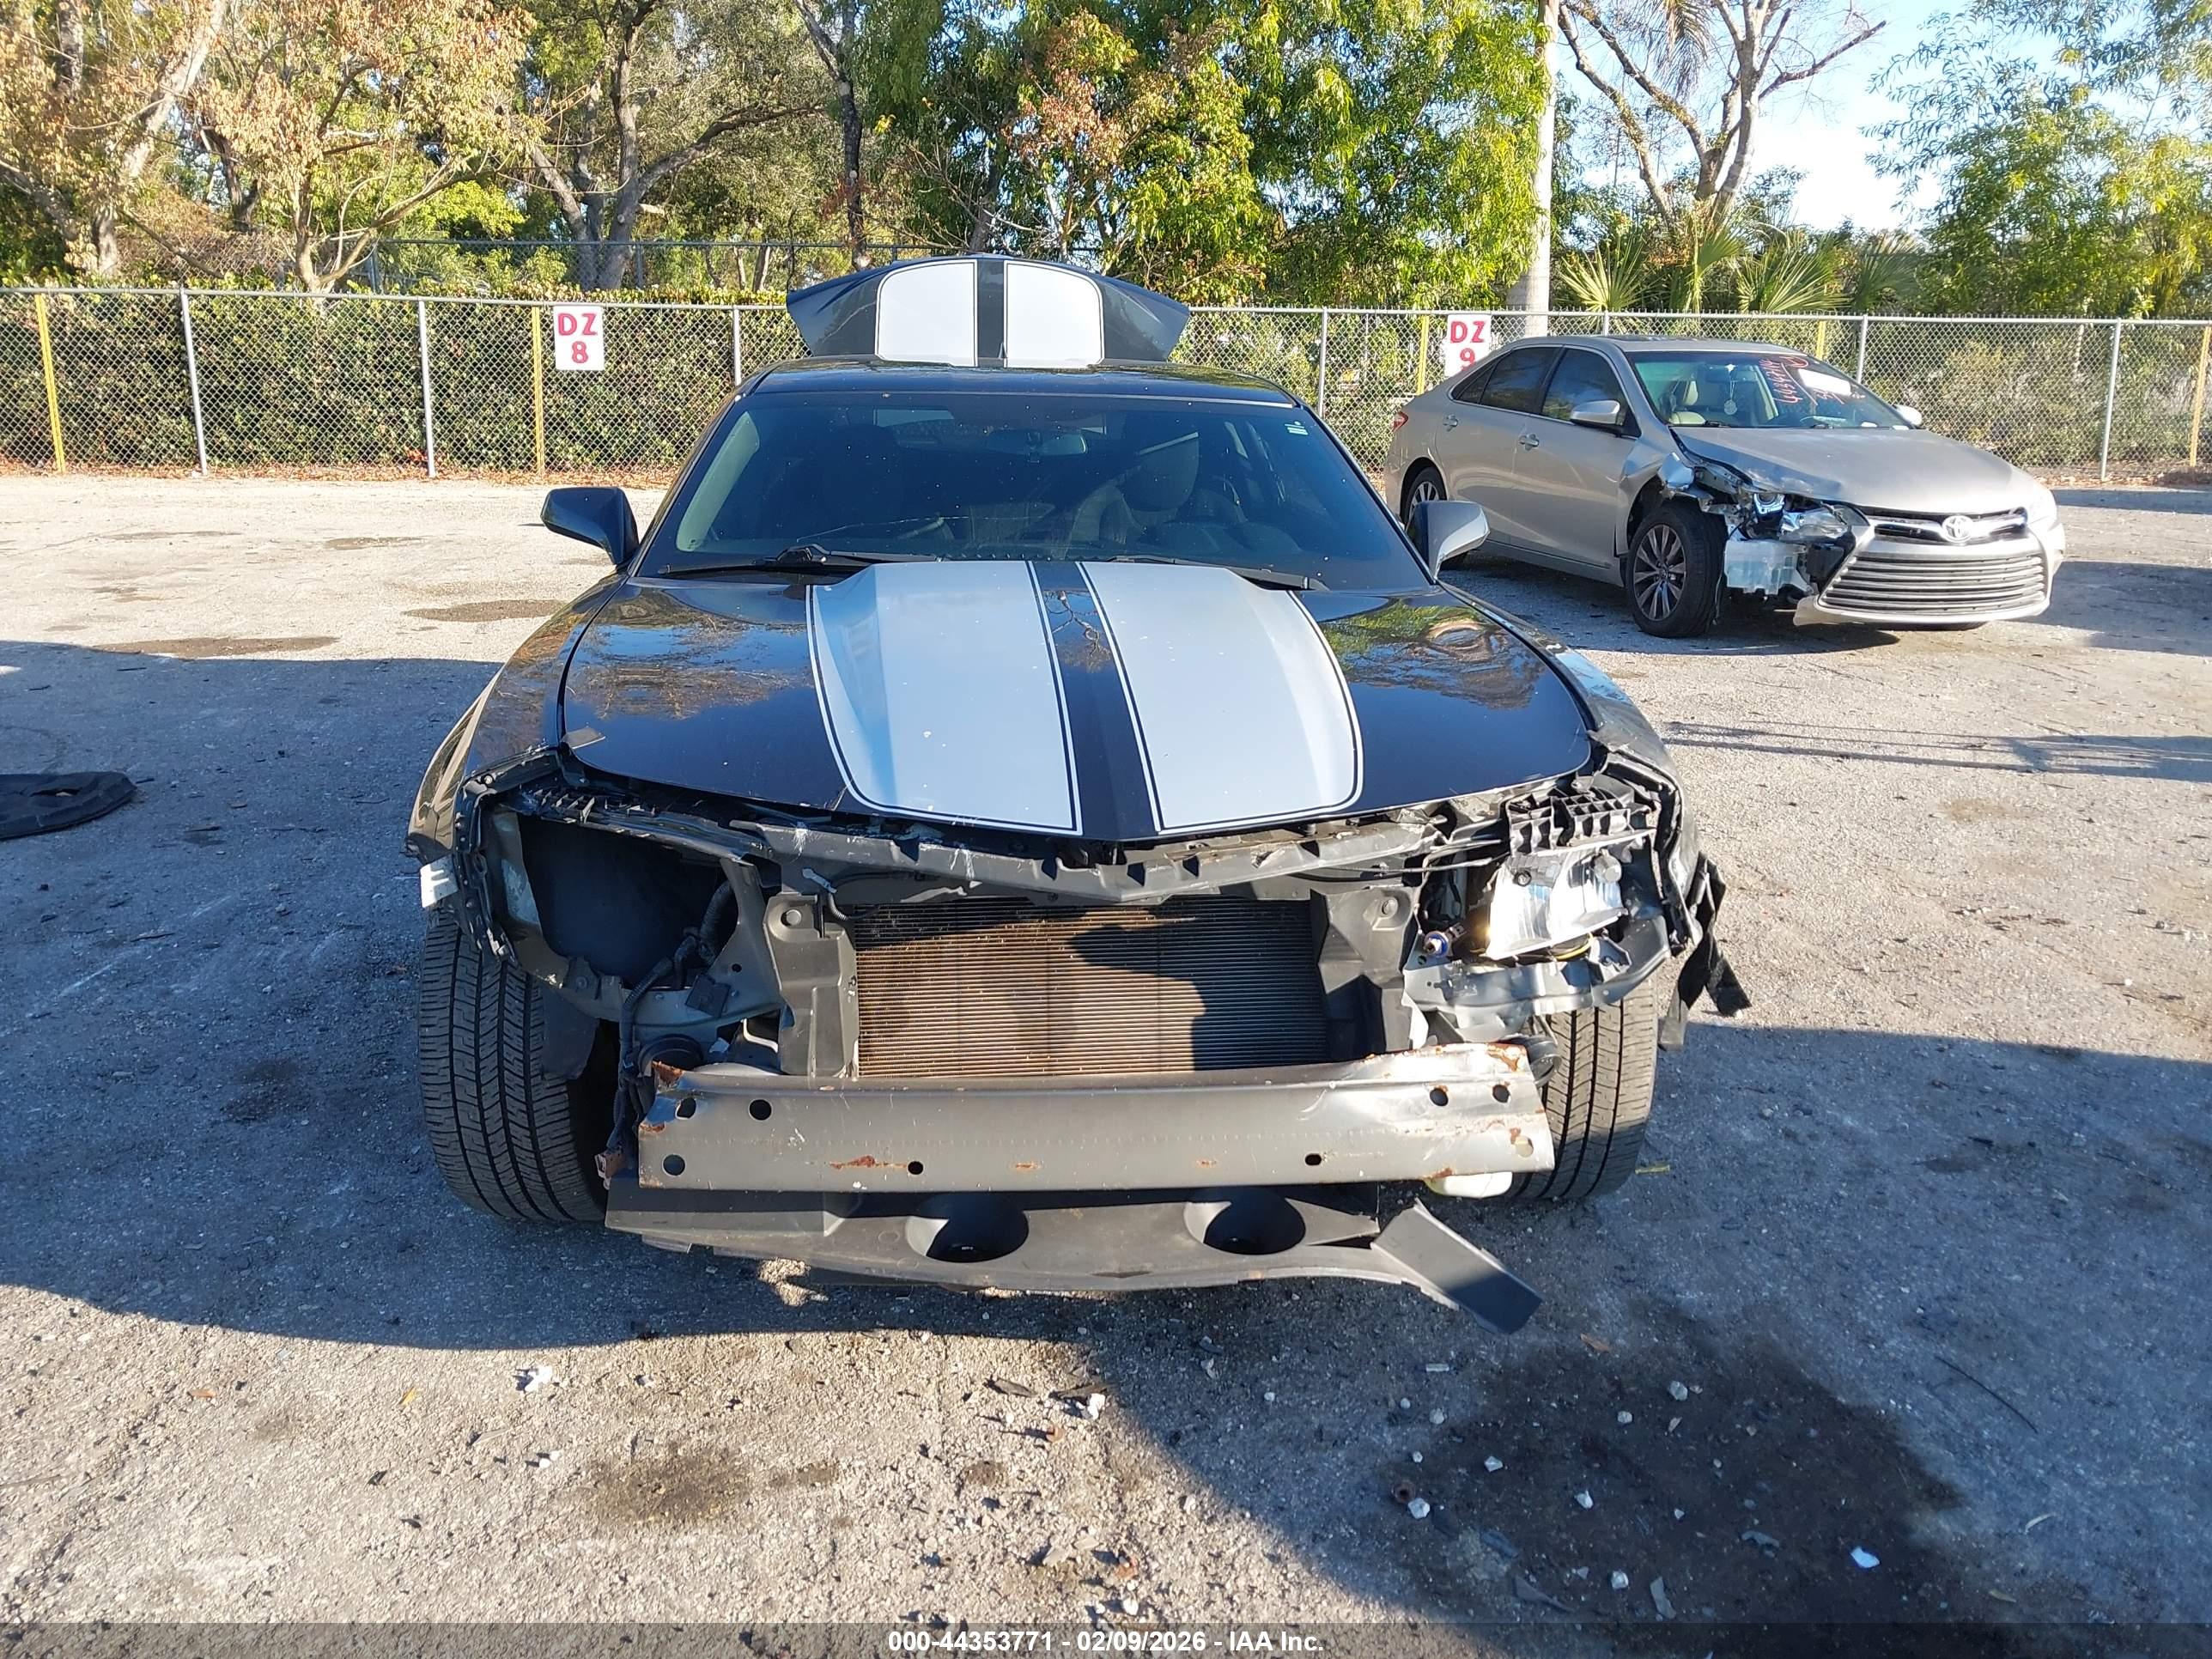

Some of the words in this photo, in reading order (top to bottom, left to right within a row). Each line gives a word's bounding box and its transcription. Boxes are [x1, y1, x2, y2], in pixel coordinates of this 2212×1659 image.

[557, 313, 598, 336] DZ
[1449, 320, 1486, 343] DZ
[571, 341, 588, 363] 8
[1459, 348, 1475, 371] 9
